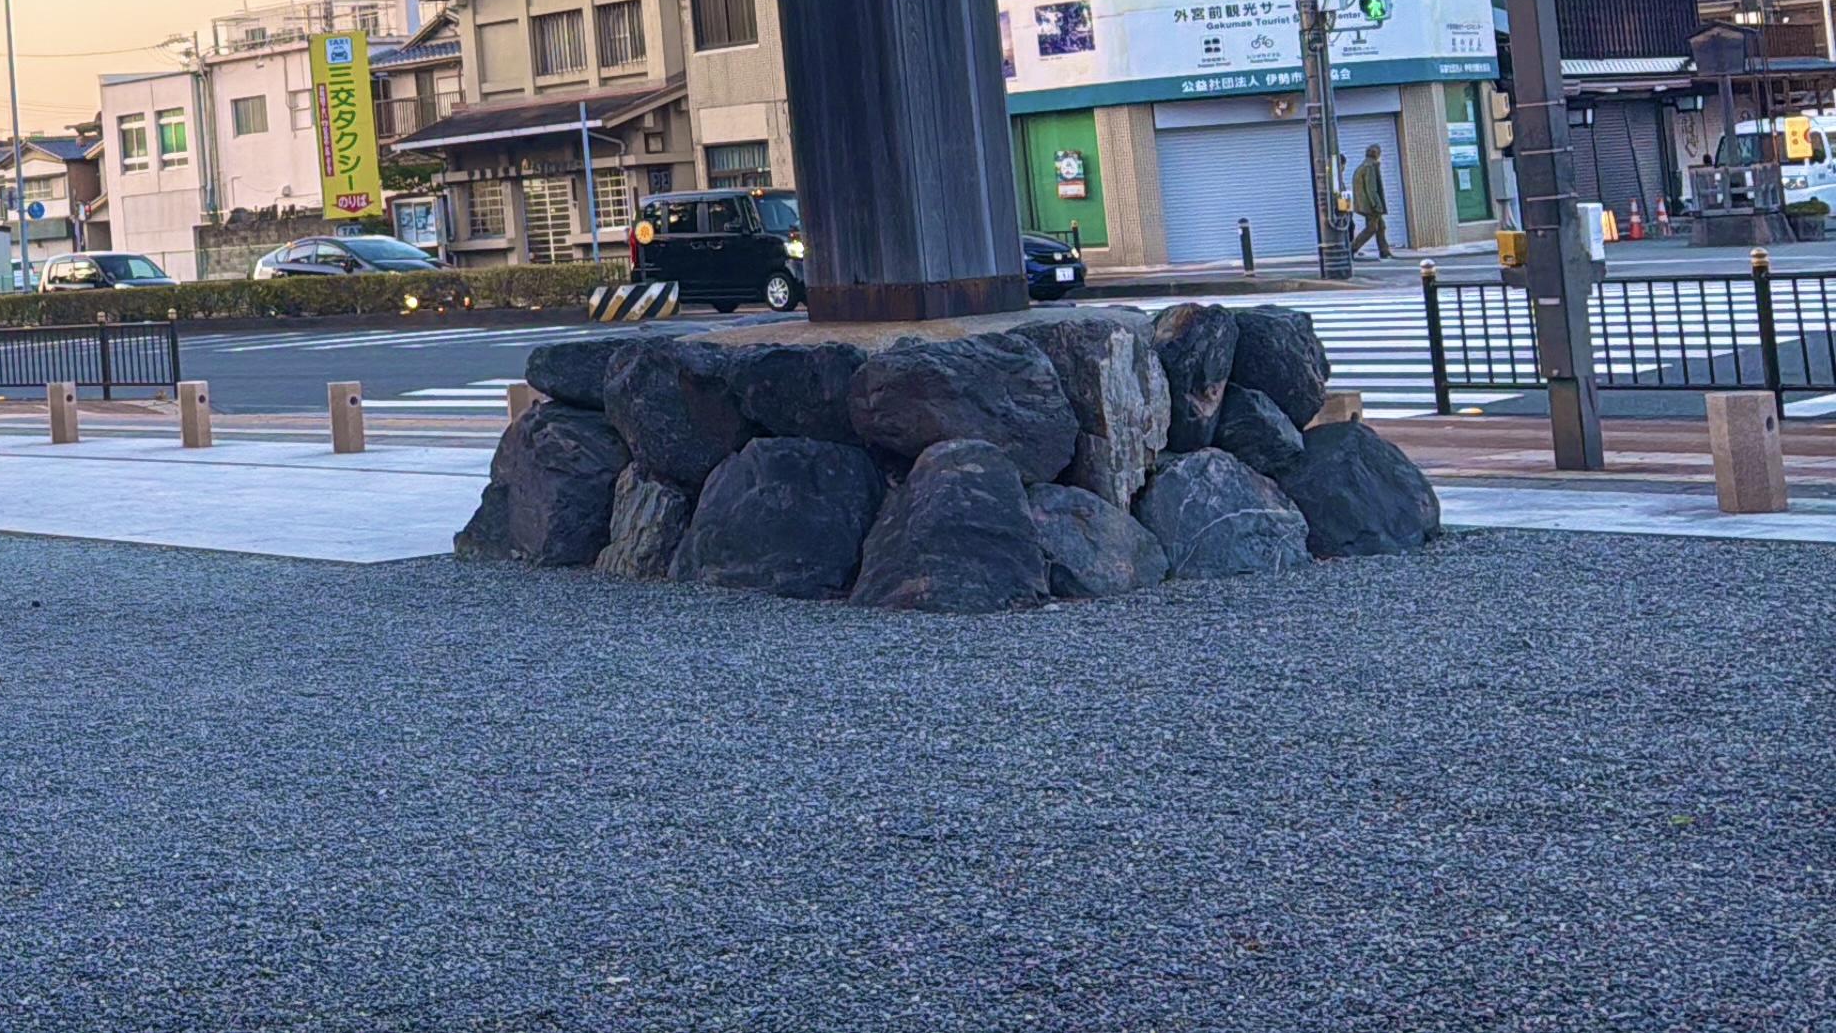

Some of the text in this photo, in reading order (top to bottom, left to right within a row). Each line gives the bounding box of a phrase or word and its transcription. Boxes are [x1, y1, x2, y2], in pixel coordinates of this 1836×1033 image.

[1206, 19, 1253, 31] Gekumae
[1256, 16, 1291, 27] Tourist
[1338, 12, 1361, 20] enter
[1182, 68, 1352, 93] 公益社団法人 伊勢市協会
[328, 66, 361, 191] 三交タクシー
[338, 194, 368, 209] のりば
[343, 226, 364, 236] TAX
